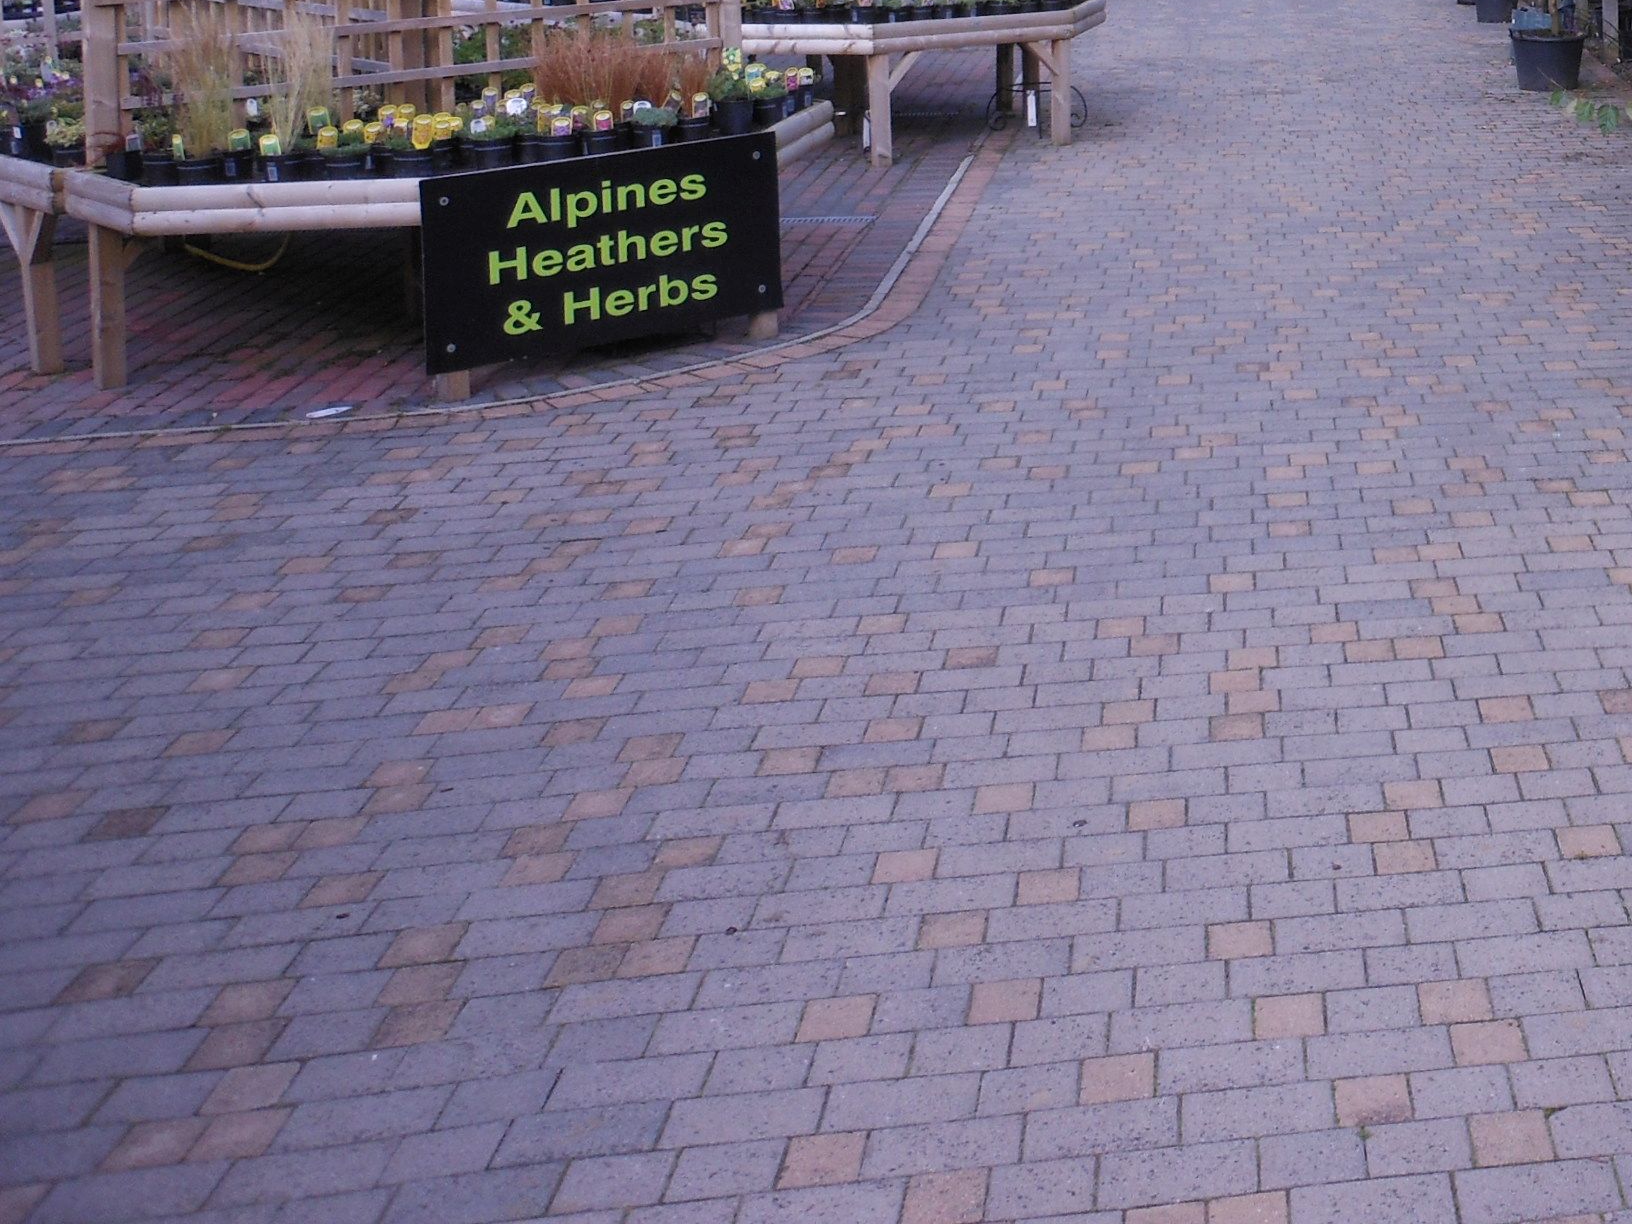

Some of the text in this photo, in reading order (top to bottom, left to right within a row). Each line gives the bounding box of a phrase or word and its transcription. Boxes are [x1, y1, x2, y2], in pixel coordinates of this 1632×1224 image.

[506, 174, 707, 229] Alpines
[488, 220, 729, 285] Heathers
[503, 273, 719, 336] & Herbs
